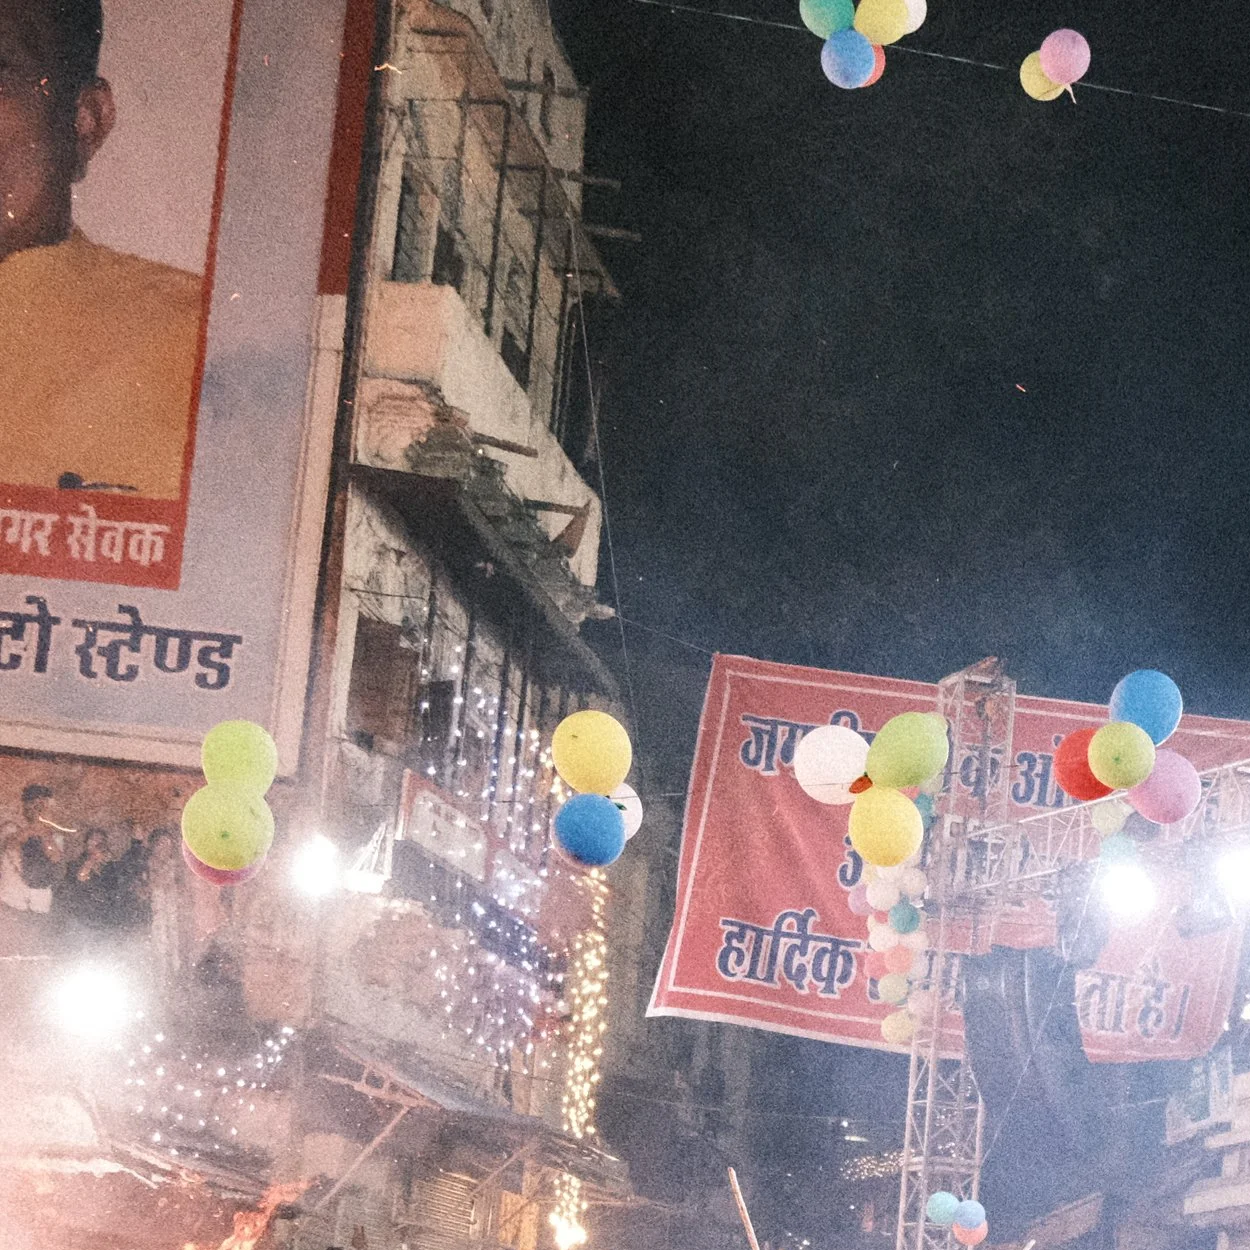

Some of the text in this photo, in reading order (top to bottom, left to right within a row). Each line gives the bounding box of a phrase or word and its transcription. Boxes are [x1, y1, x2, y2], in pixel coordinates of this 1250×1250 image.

[0, 503, 171, 569] गर सेवक
[0, 595, 243, 690] टो स्टेण्ड
[717, 907, 862, 996] हार्दिक
